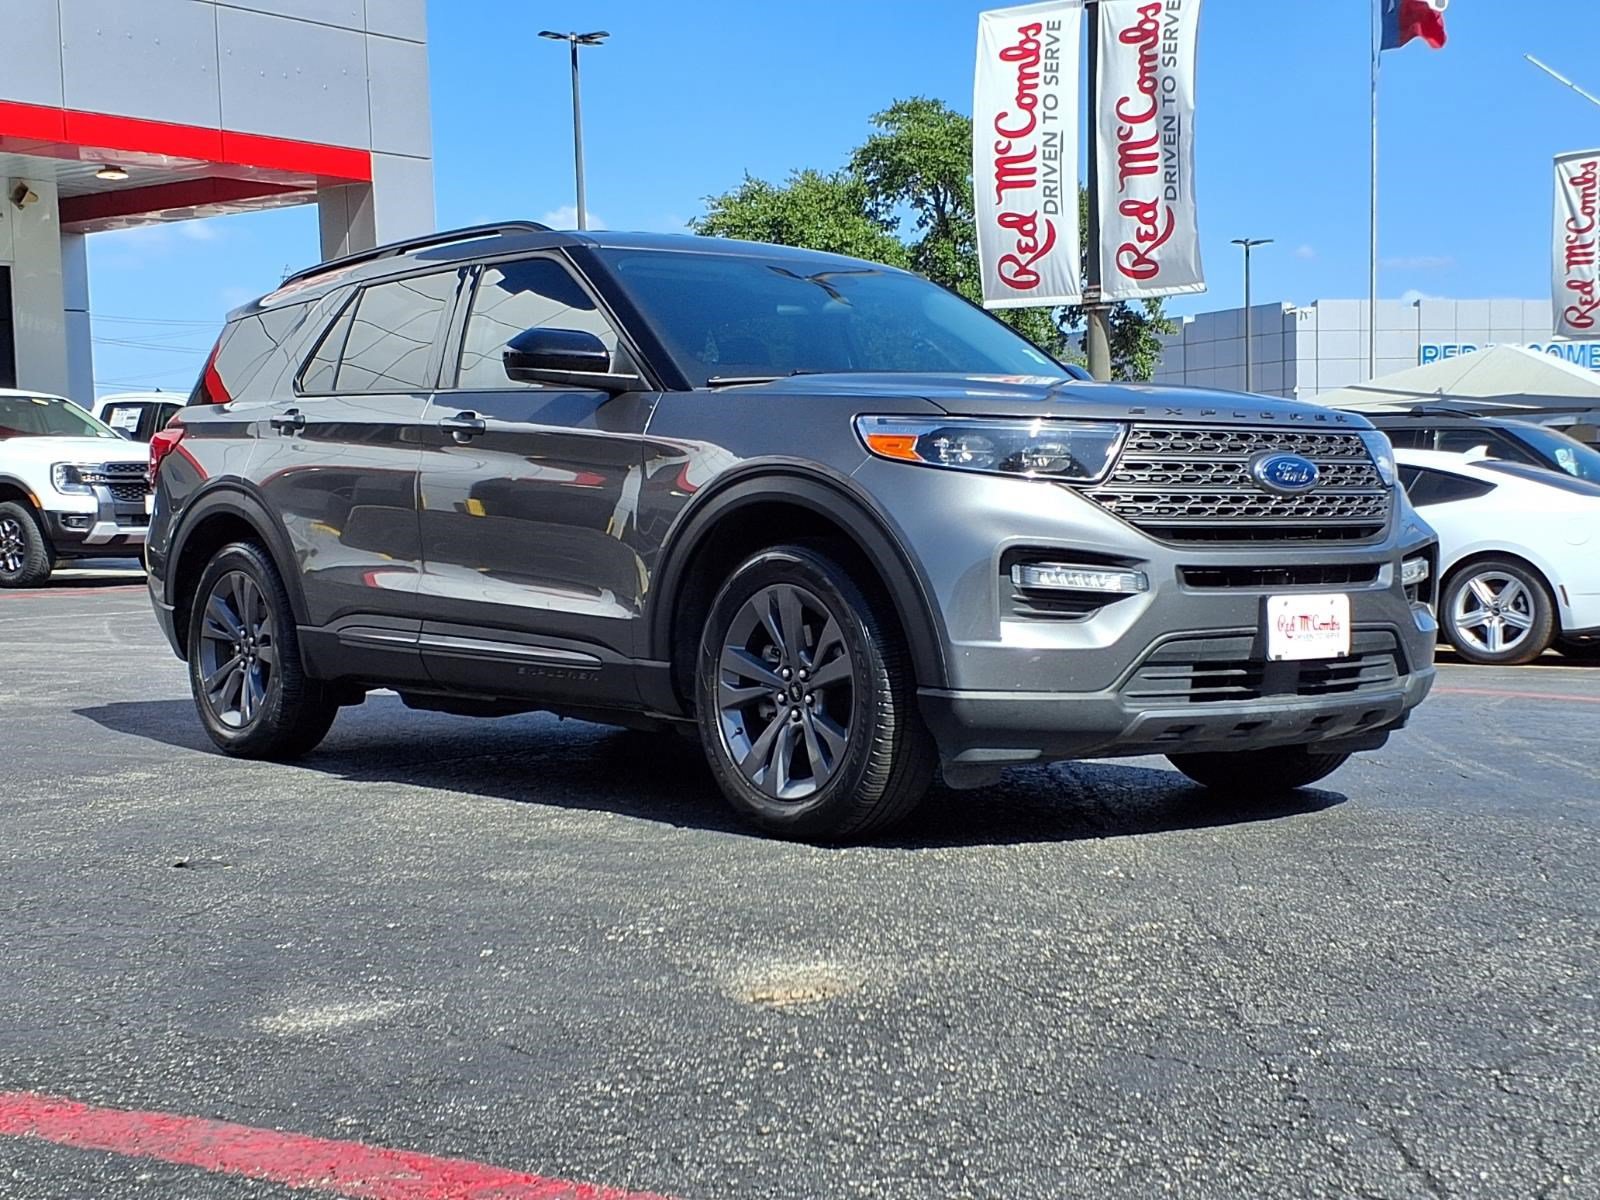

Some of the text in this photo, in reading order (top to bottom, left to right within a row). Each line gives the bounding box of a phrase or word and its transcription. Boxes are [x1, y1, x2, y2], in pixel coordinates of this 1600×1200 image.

[1043, 20, 1061, 215] DRIVEN TO SERVE
[1162, 0, 1181, 201] DRIVEN TO SERVE
[997, 210, 1056, 290] Red
[1116, 197, 1175, 280] Red
[1564, 279, 1600, 329] Red
[1128, 407, 1348, 423] EXPLORER
[1276, 462, 1308, 482] Ford
[1278, 615, 1295, 638] Red
